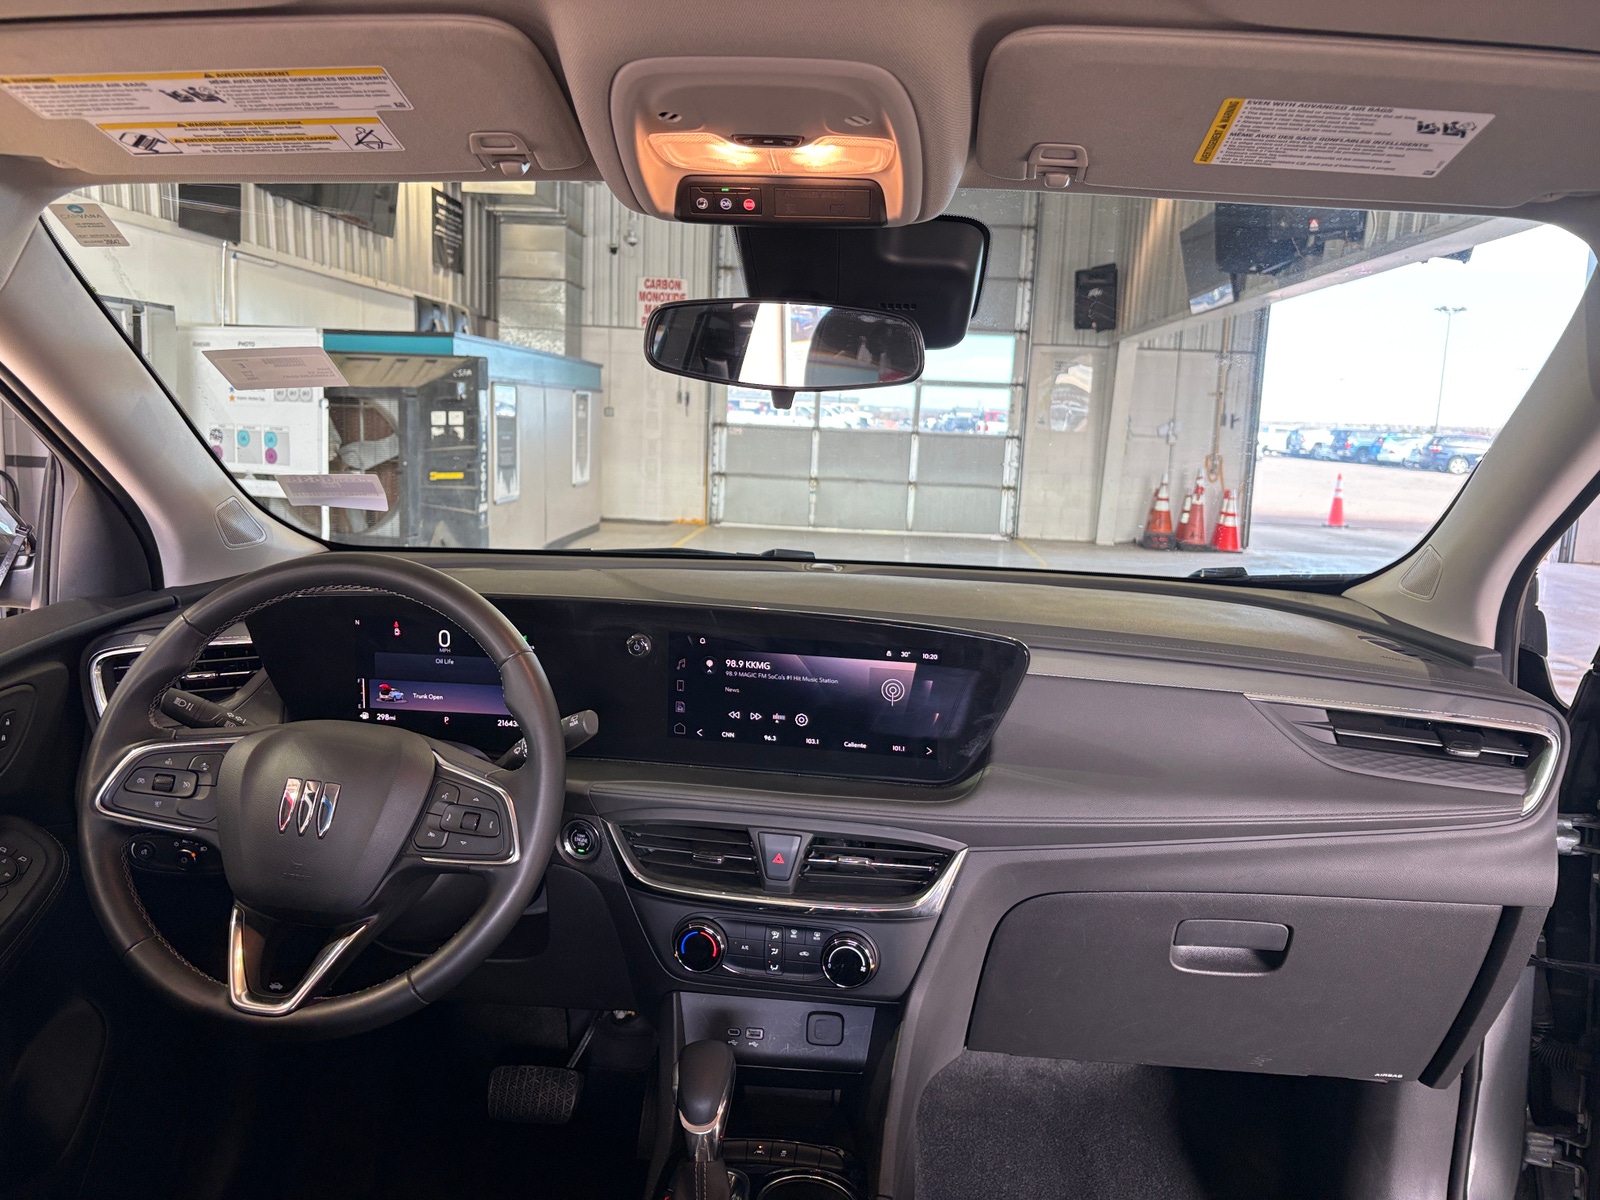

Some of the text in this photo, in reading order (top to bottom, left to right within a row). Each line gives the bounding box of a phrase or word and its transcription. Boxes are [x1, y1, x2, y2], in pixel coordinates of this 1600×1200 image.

[643, 278, 682, 291] CARBON
[638, 290, 687, 304] MONOXIDE
[438, 629, 451, 648] 0
[444, 658, 455, 666] Life
[922, 653, 938, 661] 10:20
[725, 659, 771, 670] 98.9 KKMG
[738, 671, 757, 679] MAGIC
[802, 676, 818, 684] Music
[818, 677, 839, 685] Station
[412, 692, 428, 700] Trunk
[497, 719, 519, 728] 21643
[763, 734, 777, 742] 96.3
[843, 741, 867, 749] Caliente
